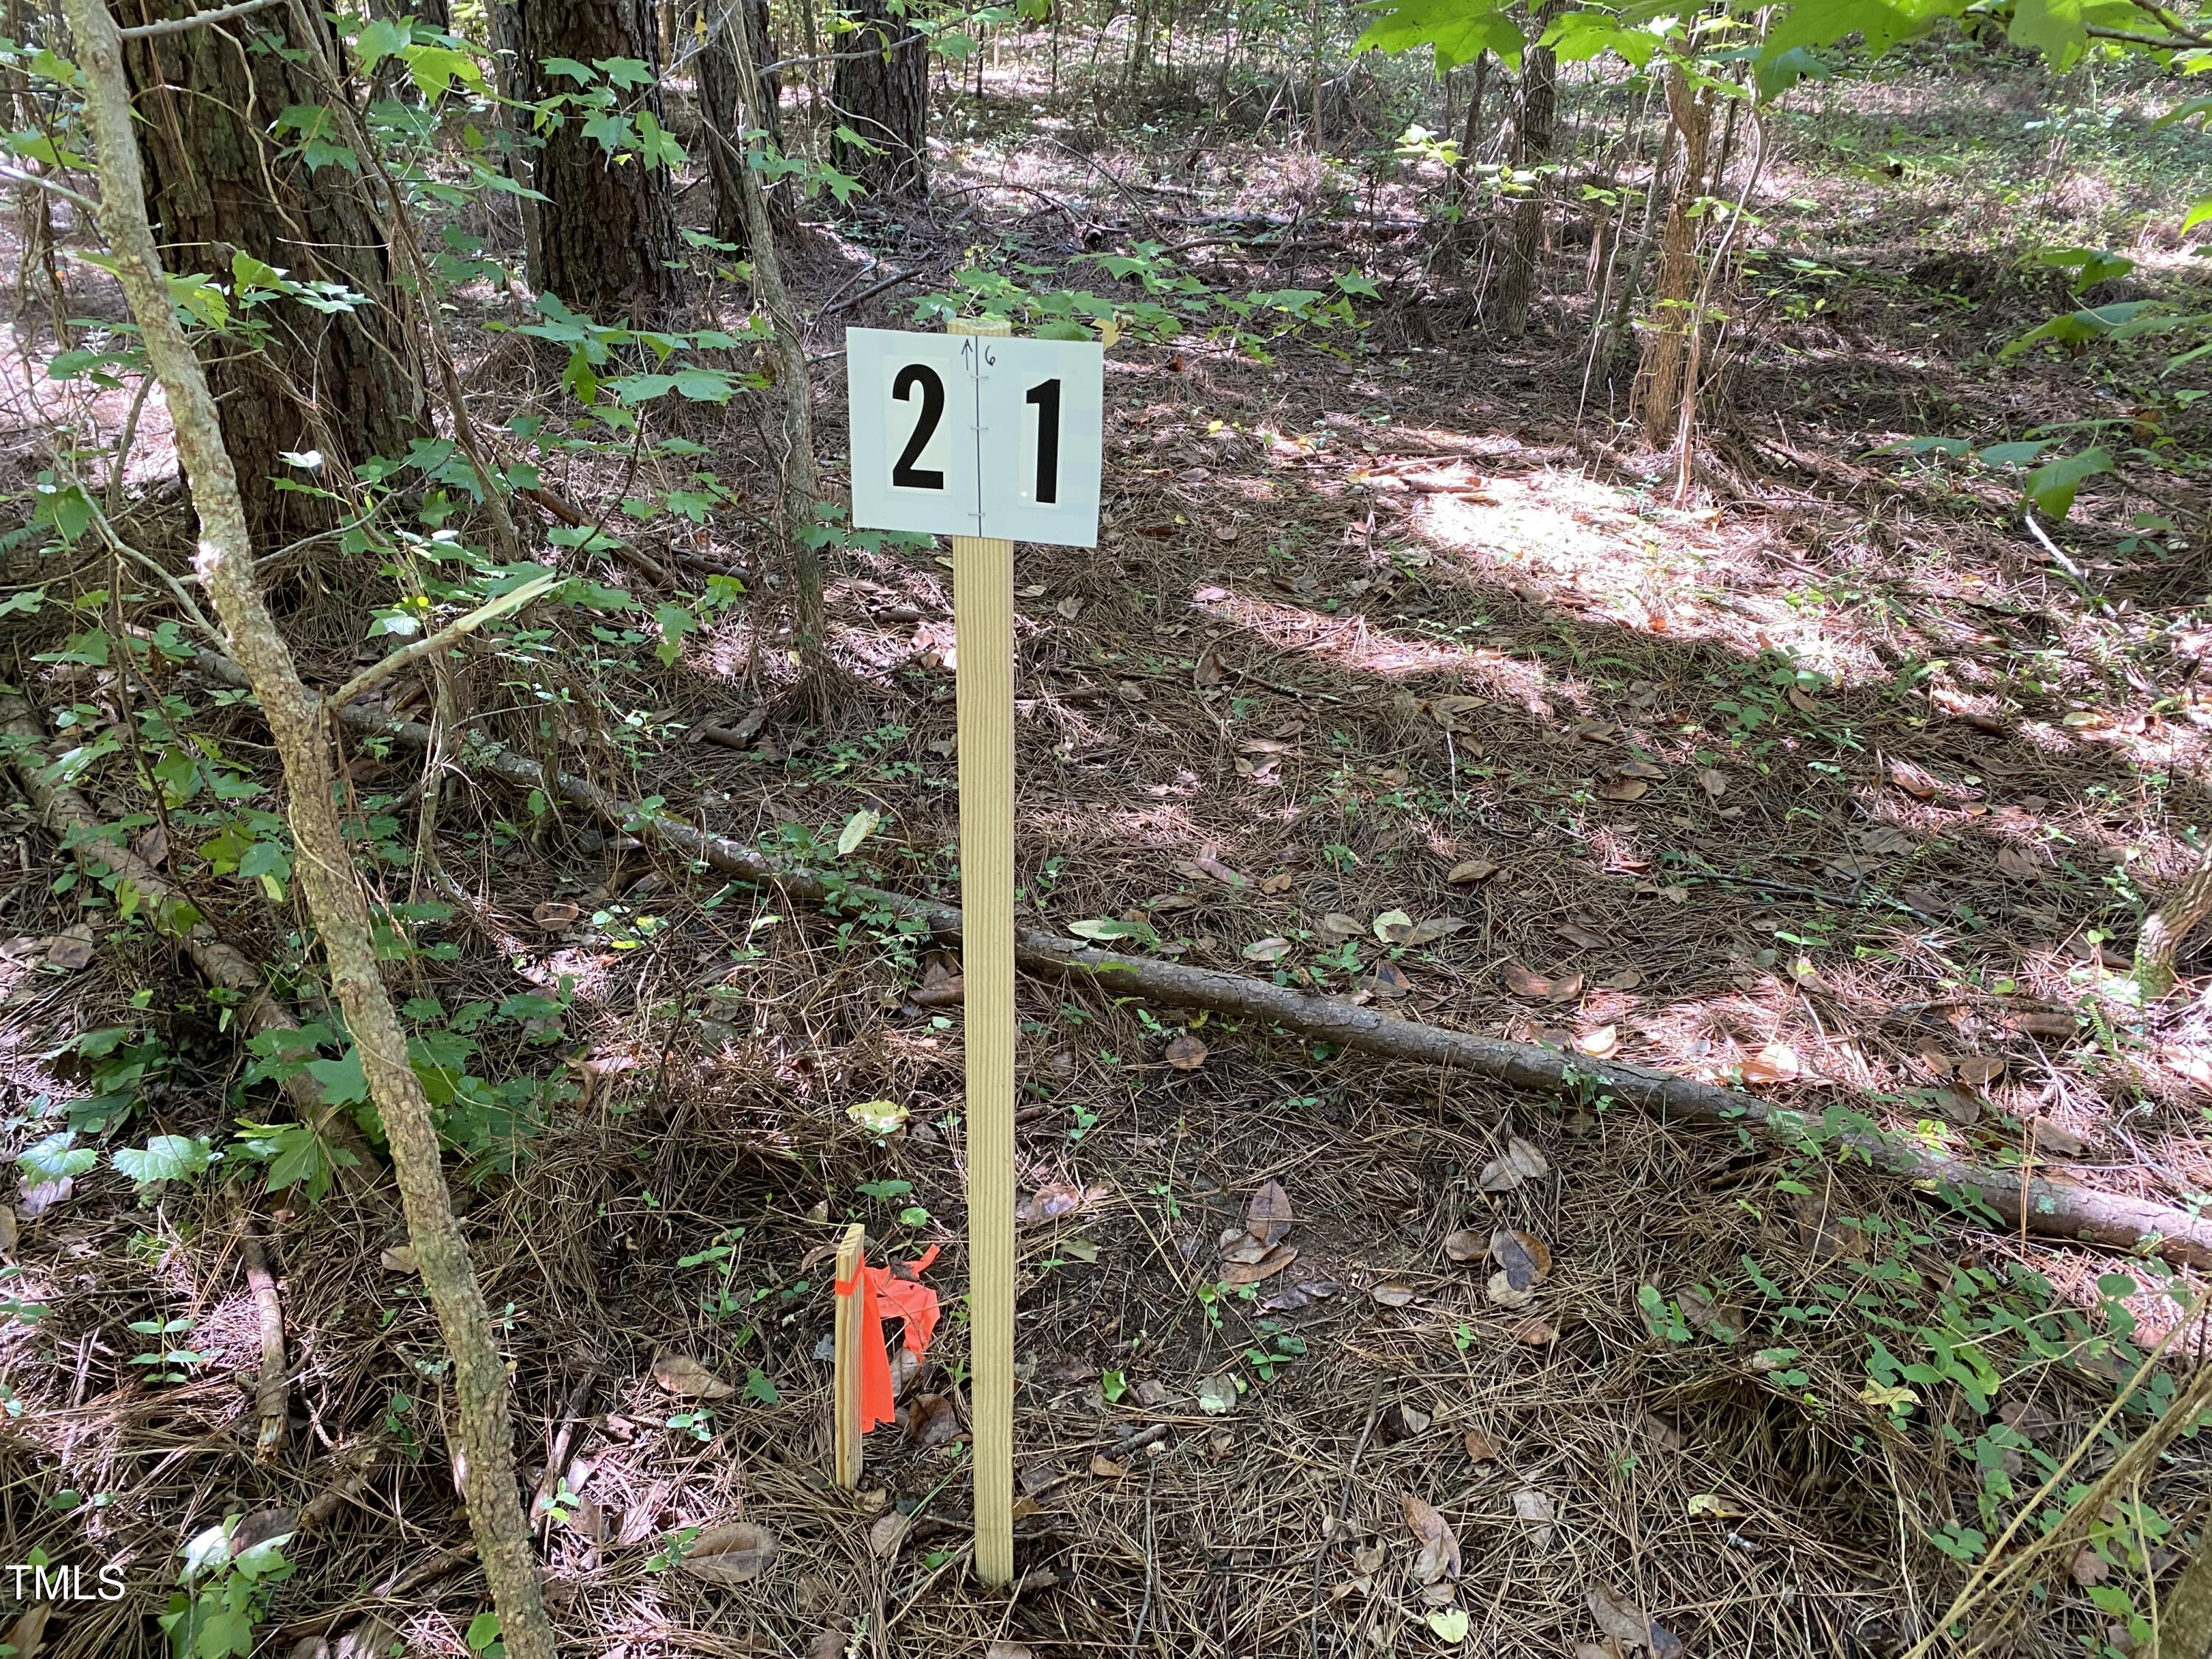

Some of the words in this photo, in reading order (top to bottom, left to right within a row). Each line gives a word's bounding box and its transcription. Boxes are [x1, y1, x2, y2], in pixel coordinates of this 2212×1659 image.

[984, 344, 996, 366] 6
[892, 364, 945, 490] 2
[1026, 378, 1061, 504] 1
